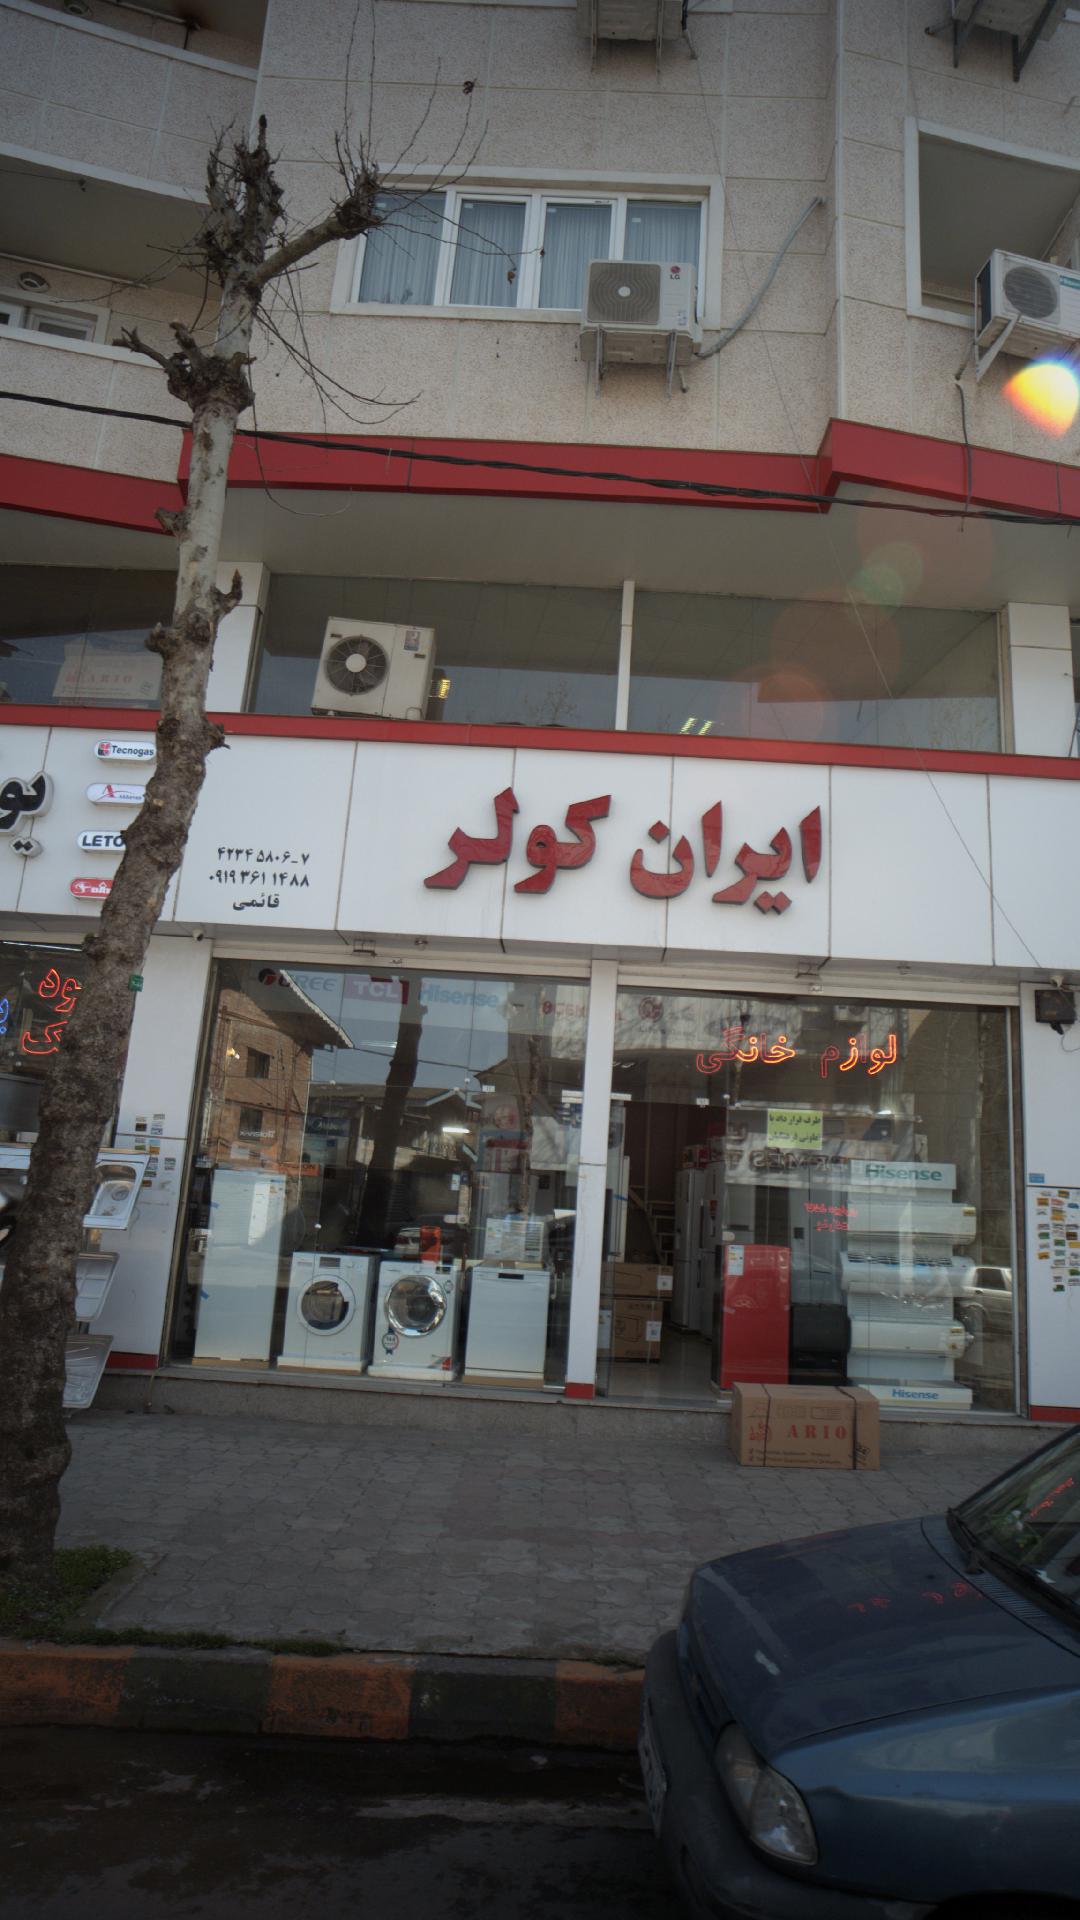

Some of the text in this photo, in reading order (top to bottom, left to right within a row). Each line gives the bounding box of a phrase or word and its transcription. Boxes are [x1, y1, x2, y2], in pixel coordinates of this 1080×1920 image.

[112, 744, 155, 757] Tecnogas
[423, 786, 823, 915] ایران کولر
[272, 871, 310, 888] ۱۴۸۸
[232, 892, 281, 911] قائمی
[351, 981, 400, 998] TCL
[421, 982, 499, 1008] Hisense
[695, 1025, 898, 1078] لوازم خانگی
[865, 1164, 943, 1181] Hisense
[892, 1388, 940, 1400] Hisense
[787, 1423, 848, 1440] ARIO
